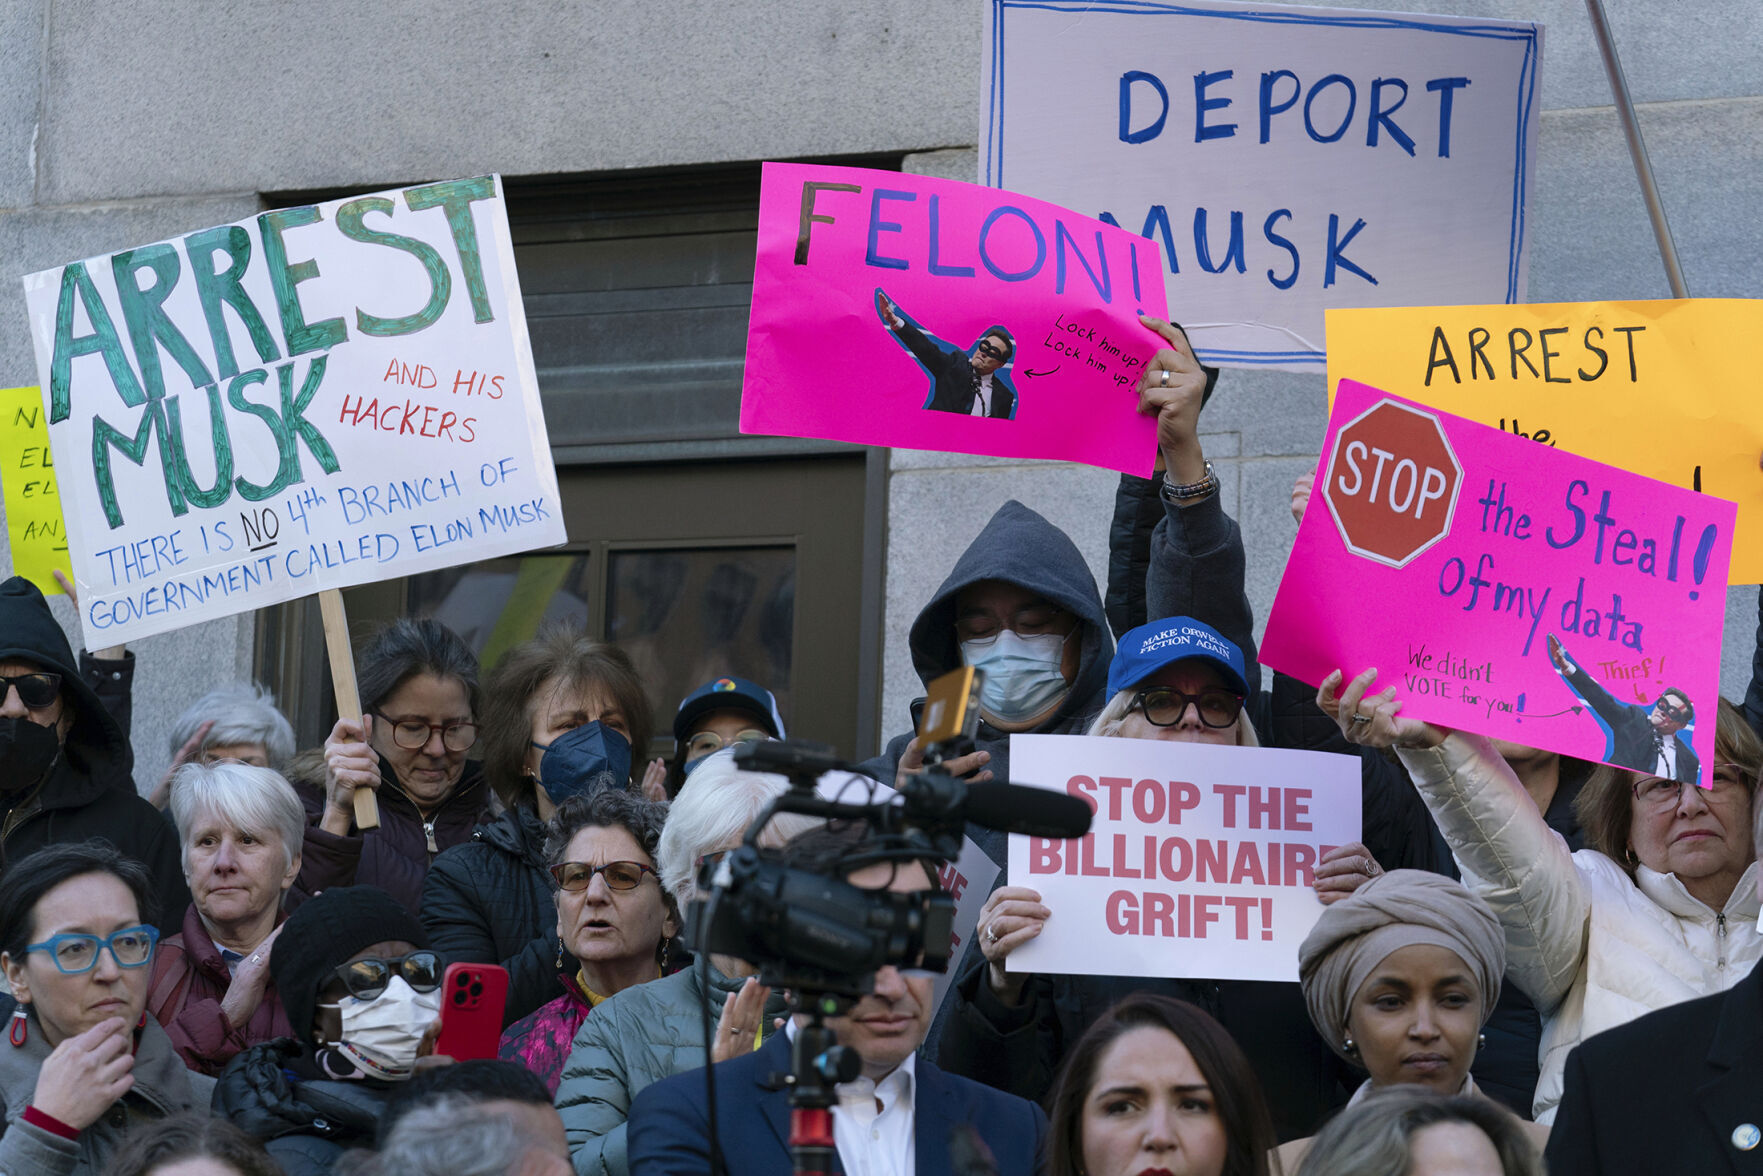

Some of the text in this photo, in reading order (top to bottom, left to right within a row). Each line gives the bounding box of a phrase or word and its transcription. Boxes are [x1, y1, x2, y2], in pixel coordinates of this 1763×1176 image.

[1118, 68, 1472, 158] DEPORT
[793, 180, 1146, 317] FELON!
[1099, 204, 1379, 290] MUSK
[49, 173, 497, 425] ARREST
[1043, 331, 1137, 393] Lock him up!
[1055, 313, 1148, 375] Lock him up!
[1424, 325, 1647, 387] ARREST
[383, 357, 505, 400] AND HIS
[91, 353, 342, 530] MUSK
[339, 393, 478, 443] HACKERS
[1337, 440, 1447, 520] STOP
[95, 456, 518, 586] THERE IS NO 4th BRANCH OF
[1477, 478, 1718, 602] the Steal!
[89, 497, 551, 630] GOVERNMENT CALLED ELON MUSK
[1139, 635, 1231, 660] FICTION AGAIN
[1142, 628, 1178, 648] MAKE
[1492, 581, 1552, 657] my
[1560, 577, 1645, 654] data
[1404, 671, 1452, 699] VOTE
[1458, 685, 1482, 705] for
[1408, 643, 1495, 684] We didn't
[1065, 774, 1313, 833] STOP THE
[1104, 889, 1274, 942] GRIFT!
